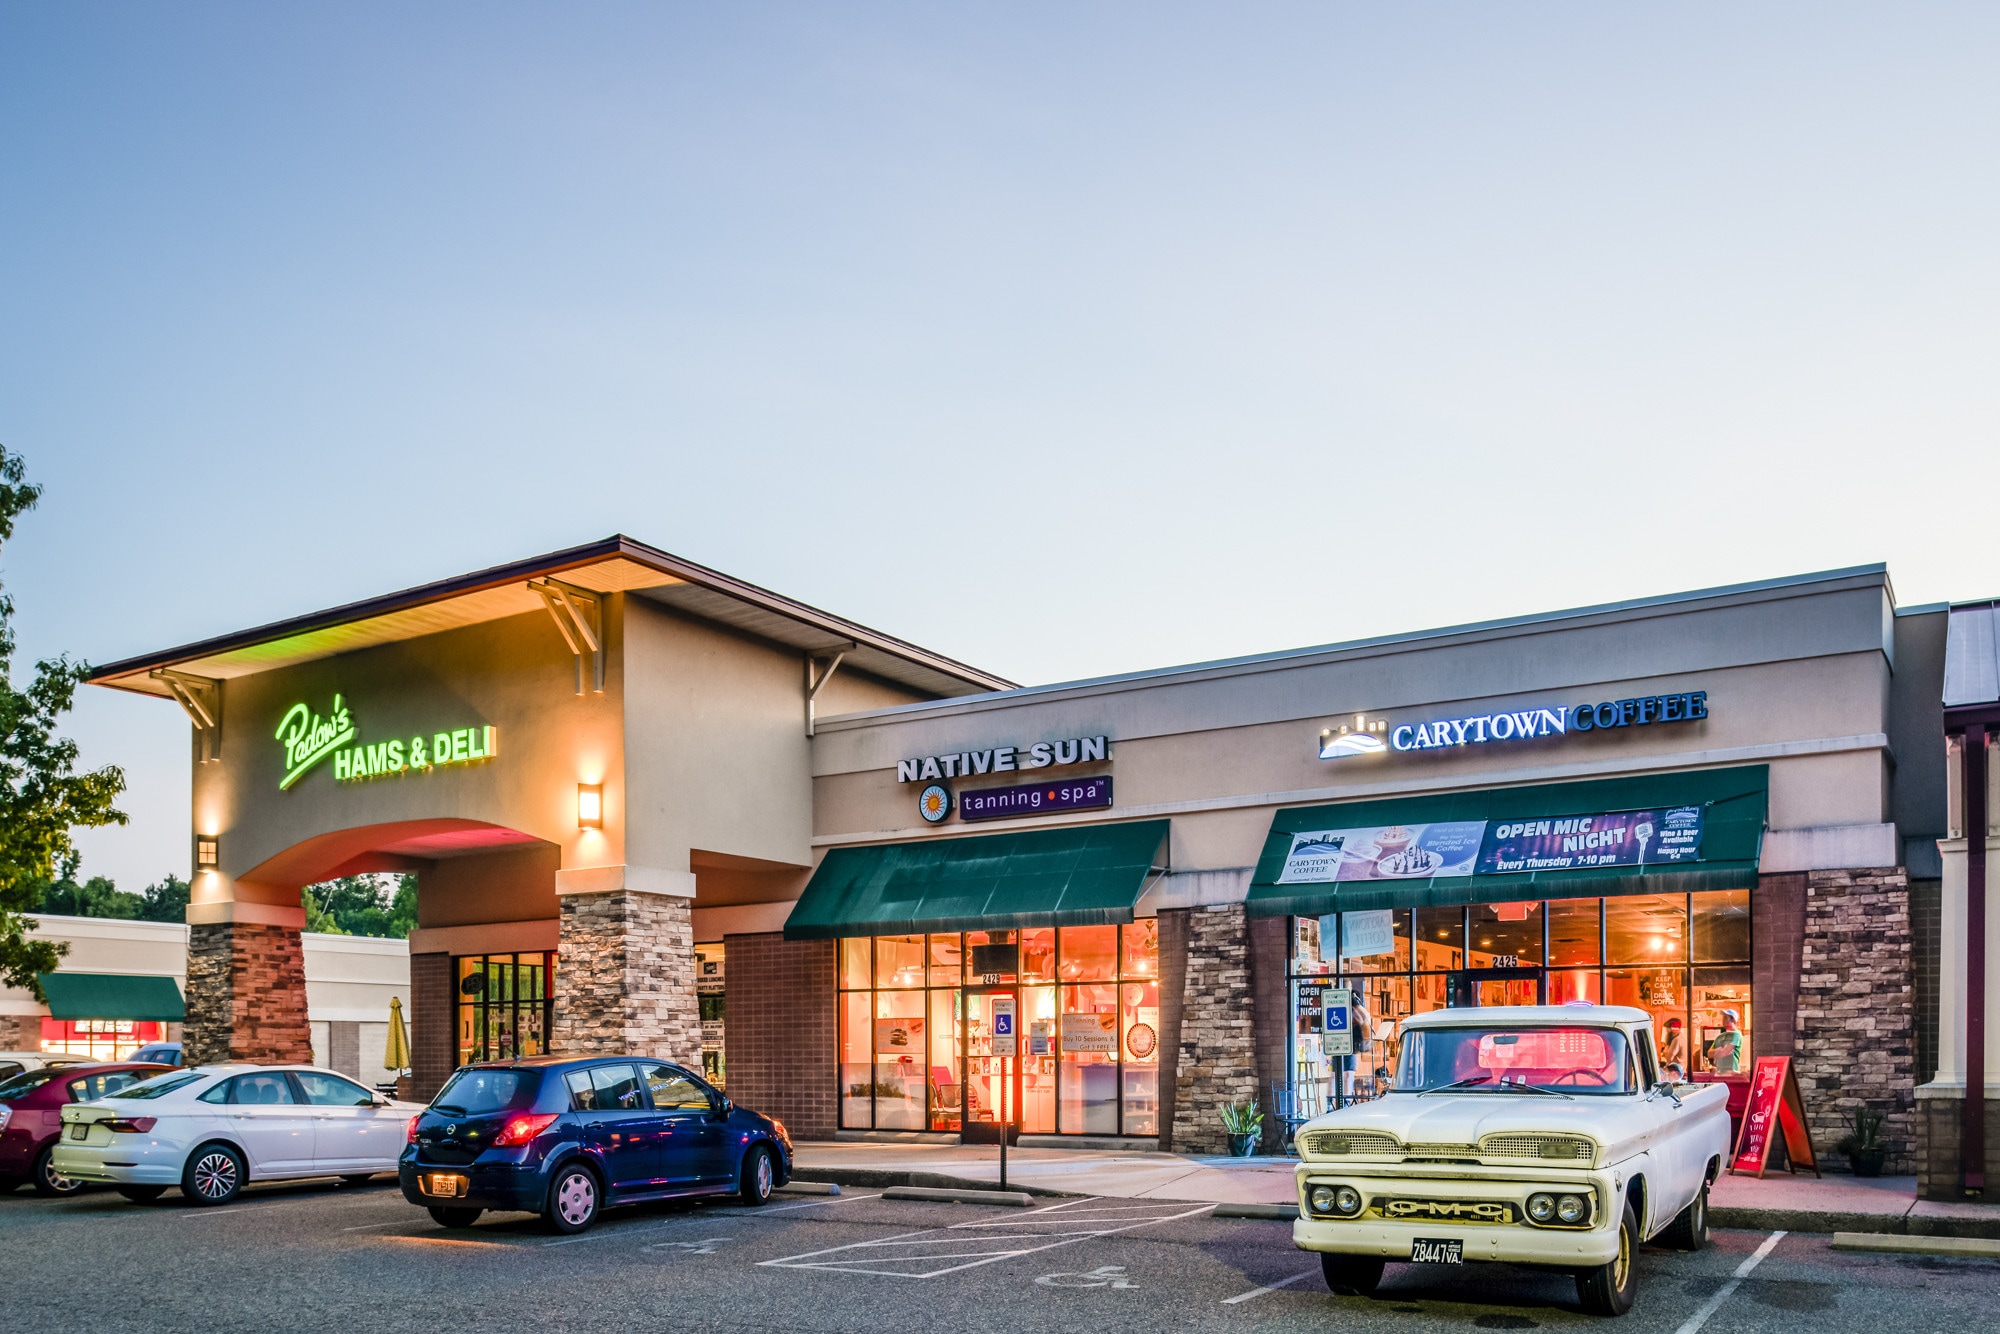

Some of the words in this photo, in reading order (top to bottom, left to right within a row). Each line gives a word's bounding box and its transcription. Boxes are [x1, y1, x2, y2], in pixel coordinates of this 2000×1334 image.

[1392, 706, 1568, 751] CARYTOWN
[1571, 690, 1708, 732] COFFEE
[275, 693, 351, 771] Padow's
[334, 740, 404, 780] HAMS
[409, 736, 428, 769] &
[433, 725, 495, 764] DELI
[897, 746, 1018, 783] NATIVE
[1030, 735, 1108, 768] SUN
[964, 791, 1041, 810] tanning
[1060, 786, 1097, 803] spa
[1496, 820, 1551, 840] OPEN
[1553, 818, 1593, 836] MIC
[1426, 839, 1462, 847] Blended
[1563, 828, 1627, 853] NIGHT
[1662, 836, 1694, 844] Available
[1657, 847, 1679, 855] Happy
[1289, 858, 1338, 867] CARYTOWN
[1497, 859, 1524, 871] Every
[1526, 855, 1573, 868] Thursday
[1577, 855, 1598, 866] 7-10
[1599, 854, 1617, 866] pm
[1293, 866, 1329, 874] COFFEE
[1492, 955, 1519, 968] 2425
[982, 974, 1000, 984] 2429
[1300, 988, 1319, 996] OPEN
[1300, 998, 1313, 1006] MIC
[1300, 1008, 1321, 1016] NIGHT
[1073, 1017, 1096, 1025] Tanning
[1388, 1201, 1503, 1216] GMC
